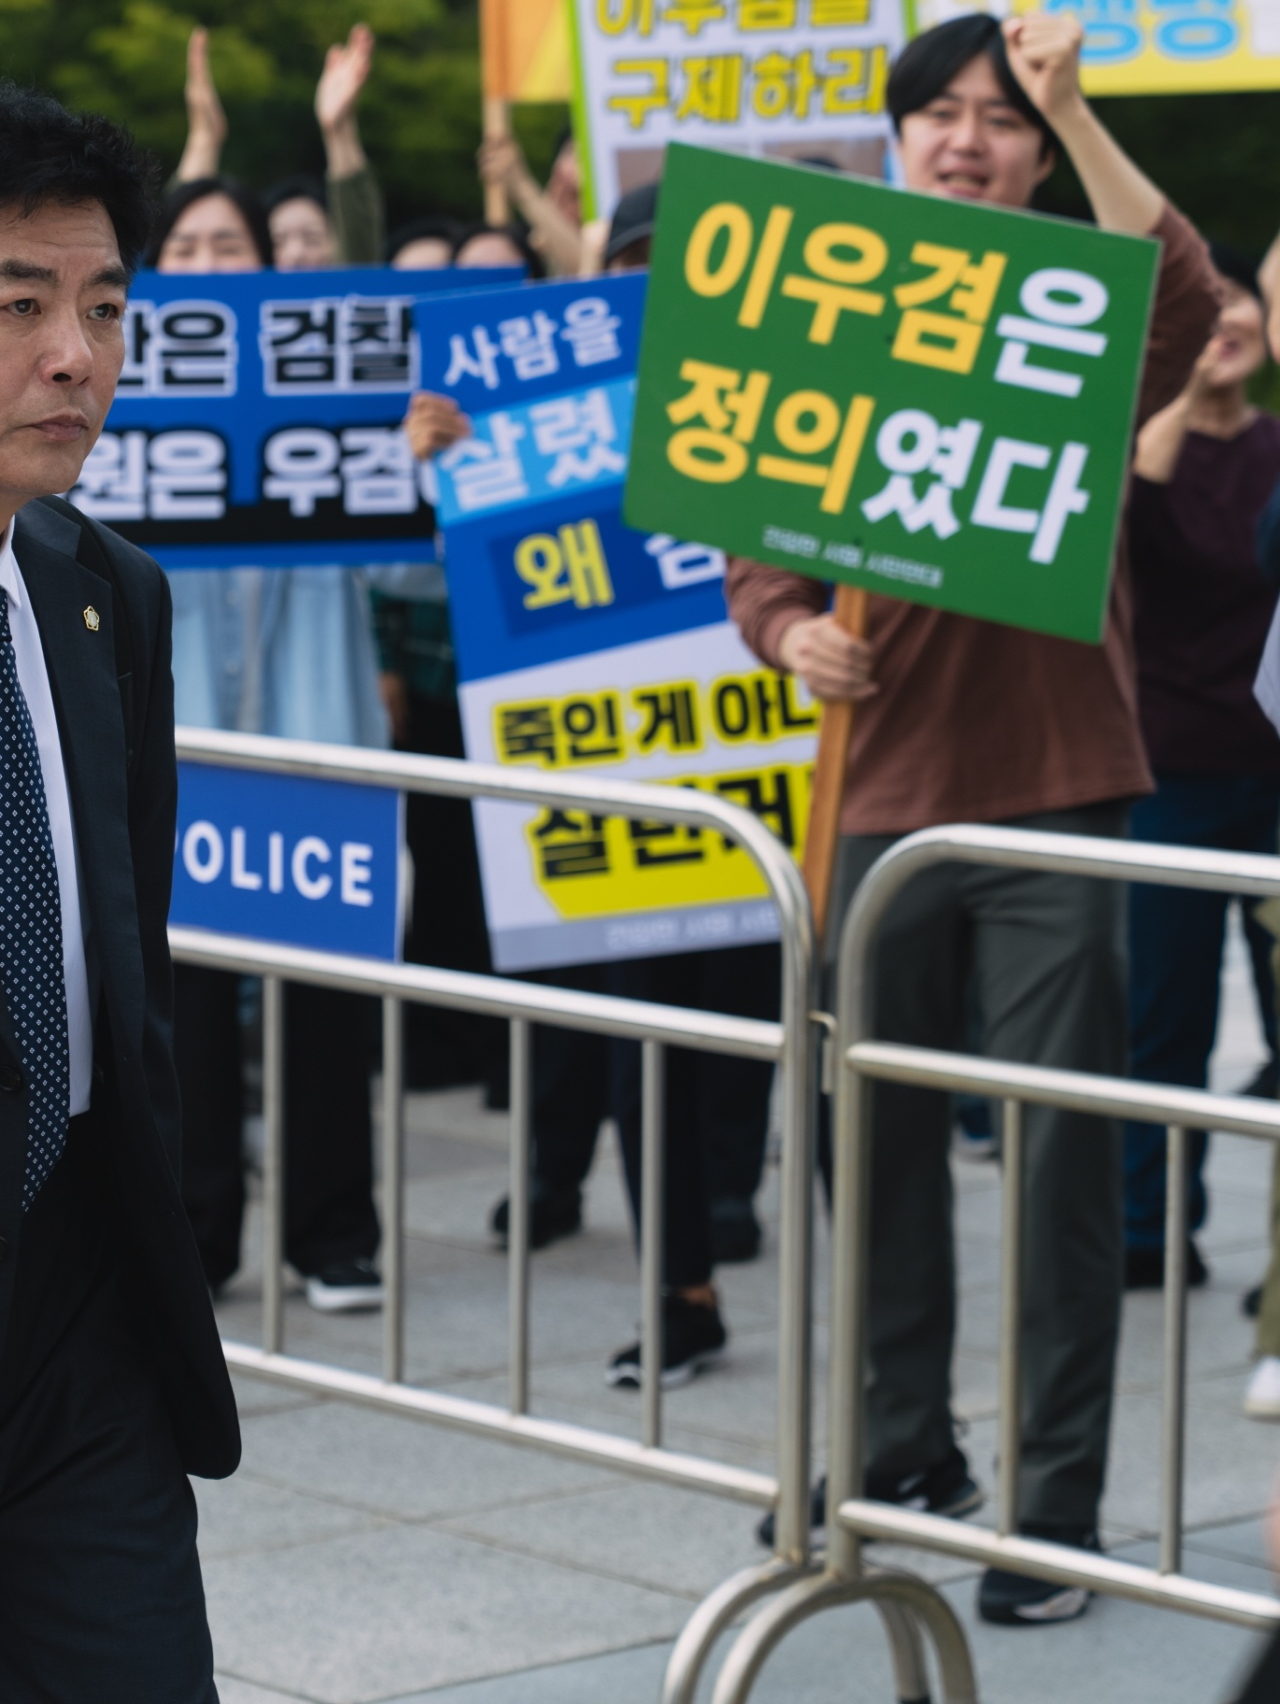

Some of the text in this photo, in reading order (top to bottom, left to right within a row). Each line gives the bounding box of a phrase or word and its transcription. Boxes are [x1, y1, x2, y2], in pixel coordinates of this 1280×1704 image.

[260, 293, 418, 396] 검찰
[443, 296, 621, 391] 사람을
[683, 202, 1110, 399] 이우겸은
[261, 425, 437, 518] 우겸
[441, 372, 636, 512] 살렸
[665, 358, 1092, 566] 정의였다
[513, 518, 614, 611] 왜
[634, 685, 700, 750] 게
[176, 818, 374, 908] OLICE
